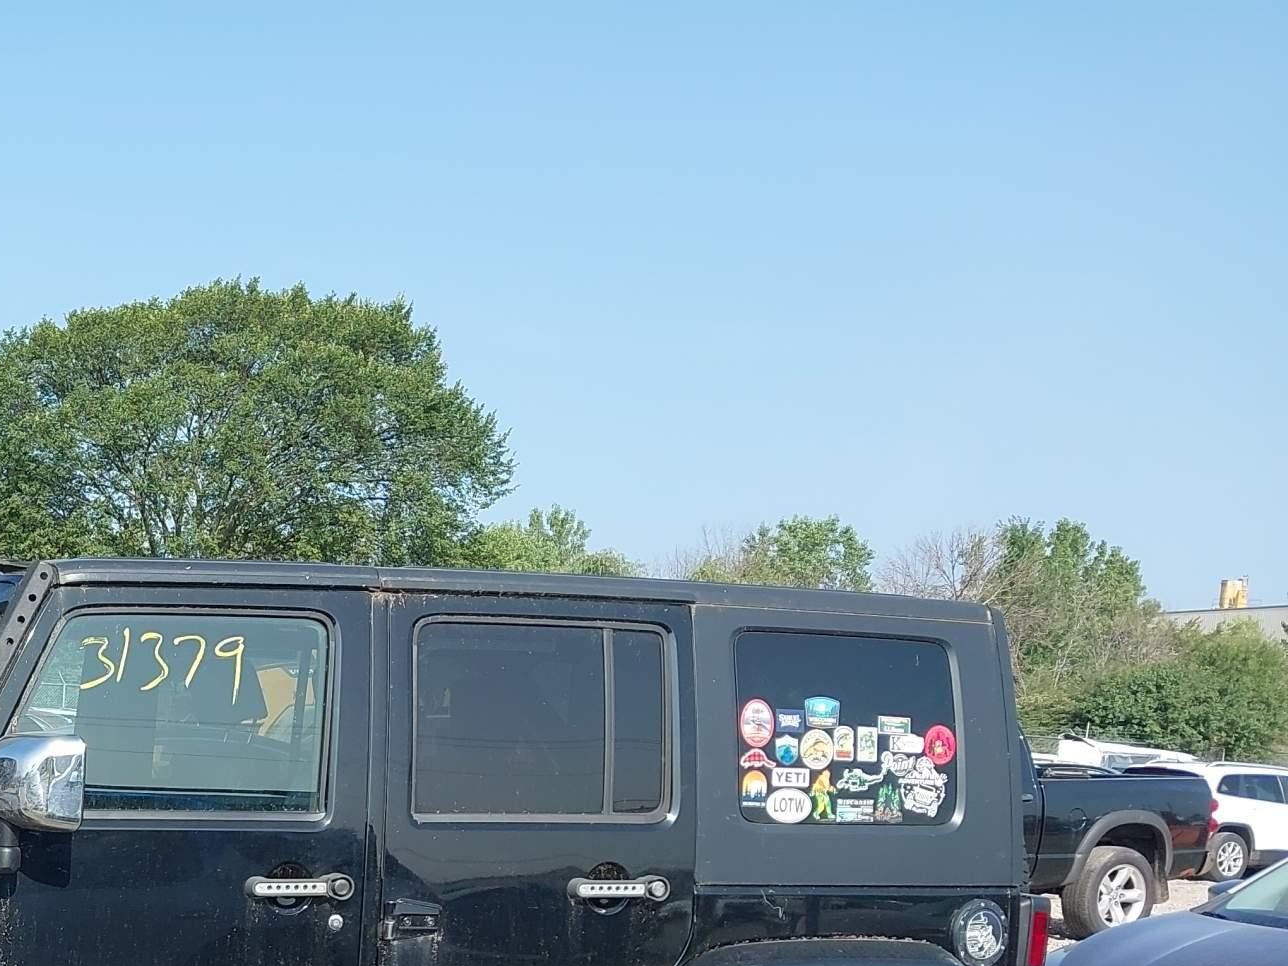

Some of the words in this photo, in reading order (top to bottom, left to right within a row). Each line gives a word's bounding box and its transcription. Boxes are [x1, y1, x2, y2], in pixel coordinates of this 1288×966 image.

[80, 627, 245, 705] 31379
[776, 771, 806, 784] YETI
[773, 798, 805, 813] LOTW
